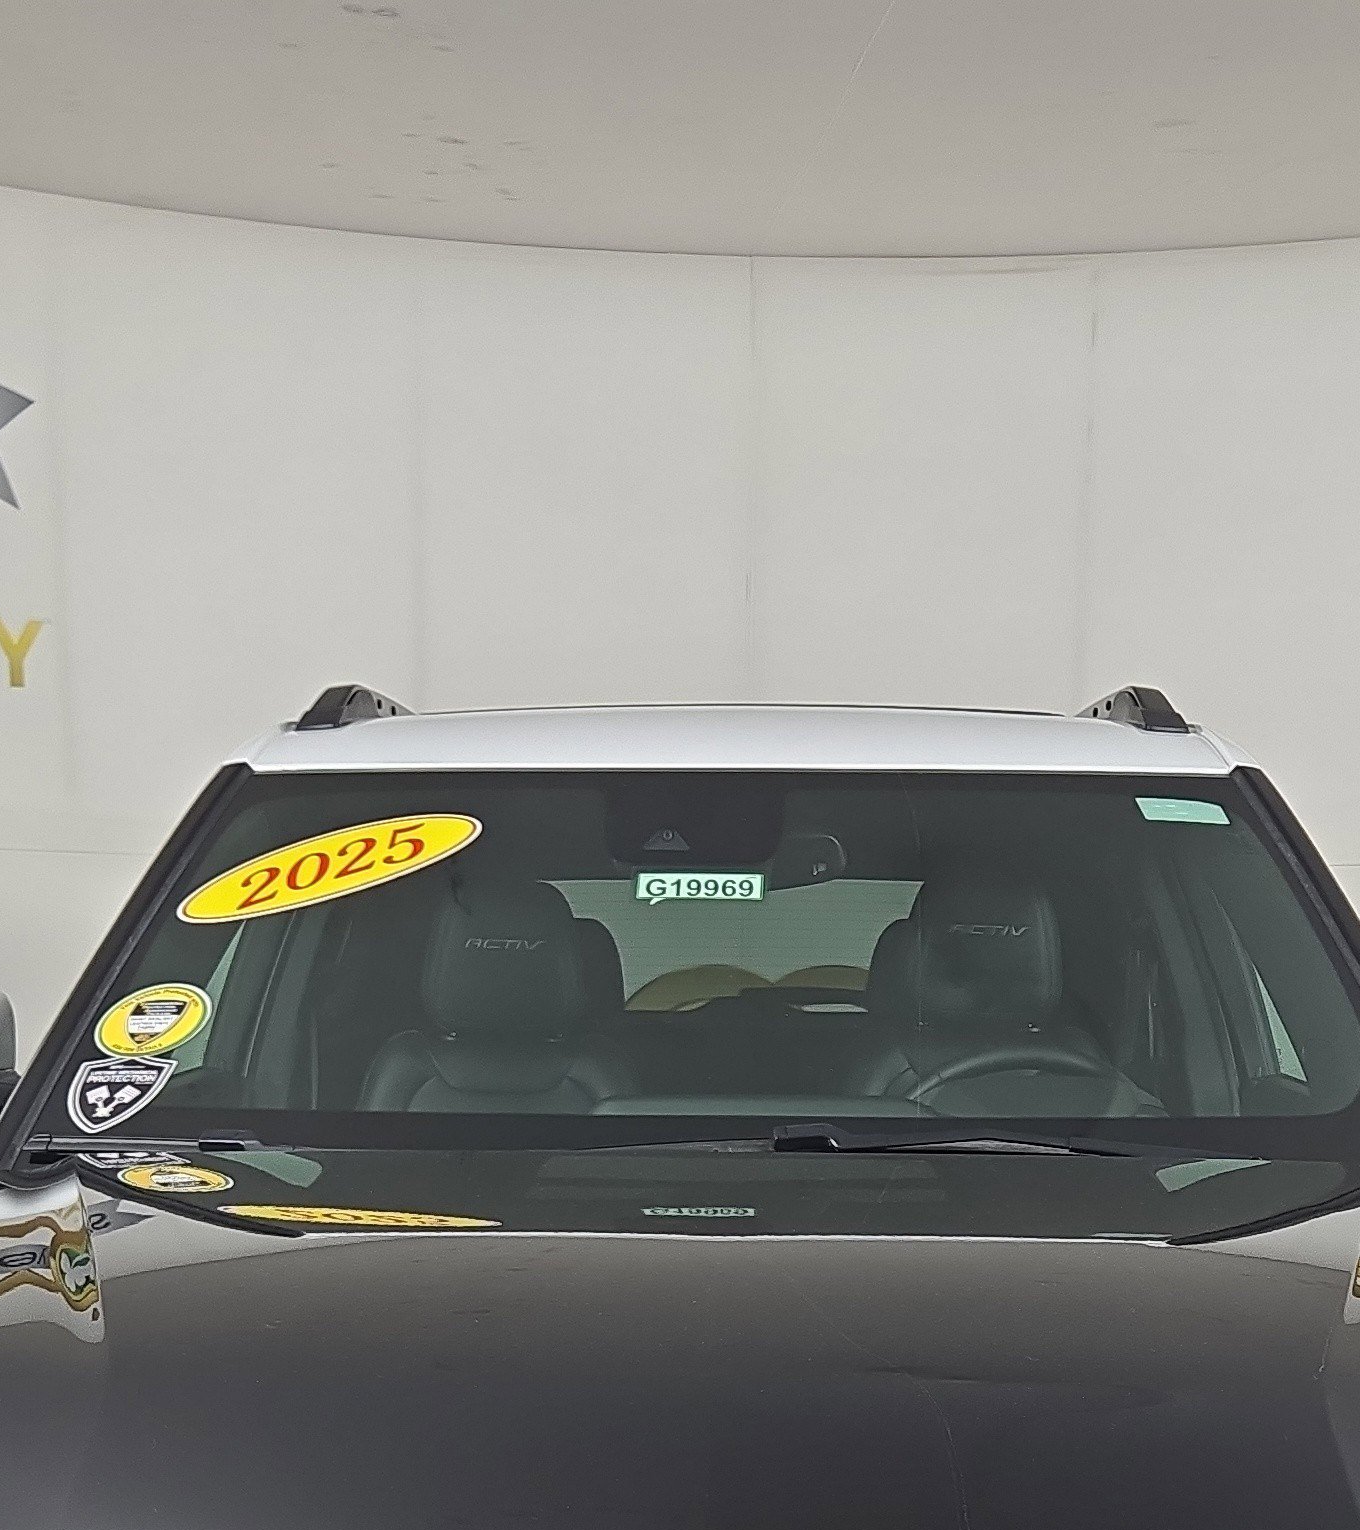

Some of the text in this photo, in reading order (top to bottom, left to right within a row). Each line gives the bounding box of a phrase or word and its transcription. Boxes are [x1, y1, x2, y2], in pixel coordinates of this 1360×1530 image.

[236, 823, 426, 911] 2025
[645, 878, 754, 897] G19969
[86, 1074, 157, 1084] PROTECTION
